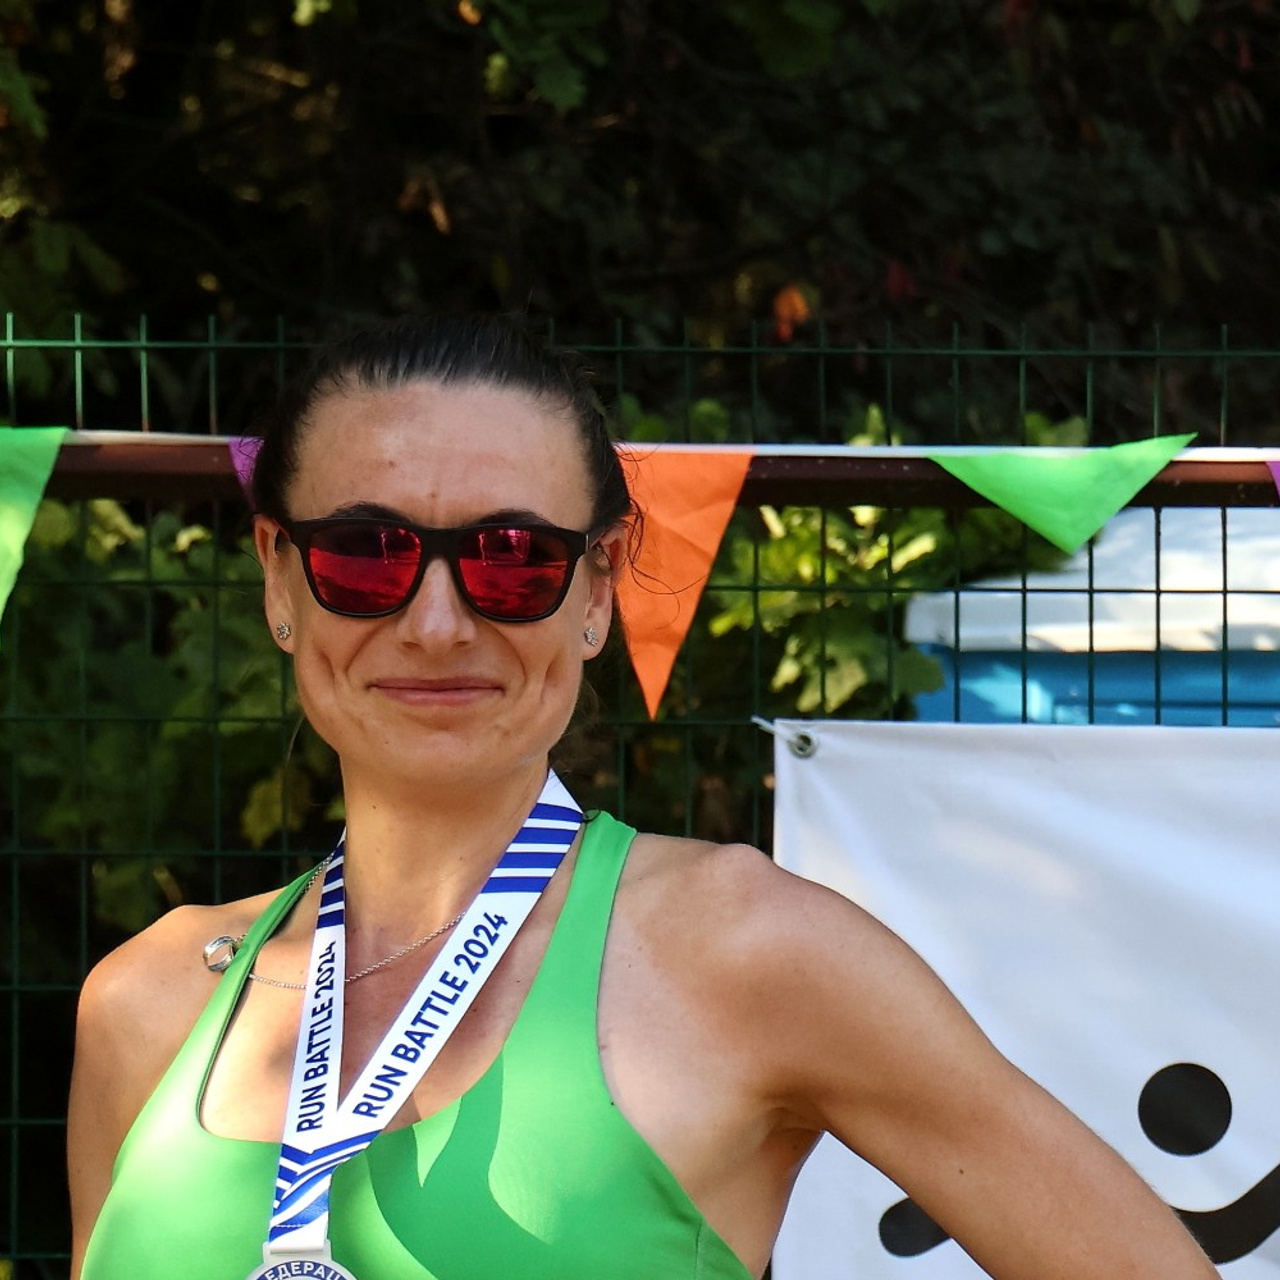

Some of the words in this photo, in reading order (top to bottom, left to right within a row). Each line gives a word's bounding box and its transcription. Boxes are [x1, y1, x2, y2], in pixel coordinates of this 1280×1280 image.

[313, 940, 336, 1000] 2024
[303, 996, 334, 1082] BATTLE
[352, 1064, 408, 1118] RUN
[390, 970, 469, 1064] BATTLE
[453, 912, 509, 975] 2024
[296, 1082, 327, 1133] RUN
